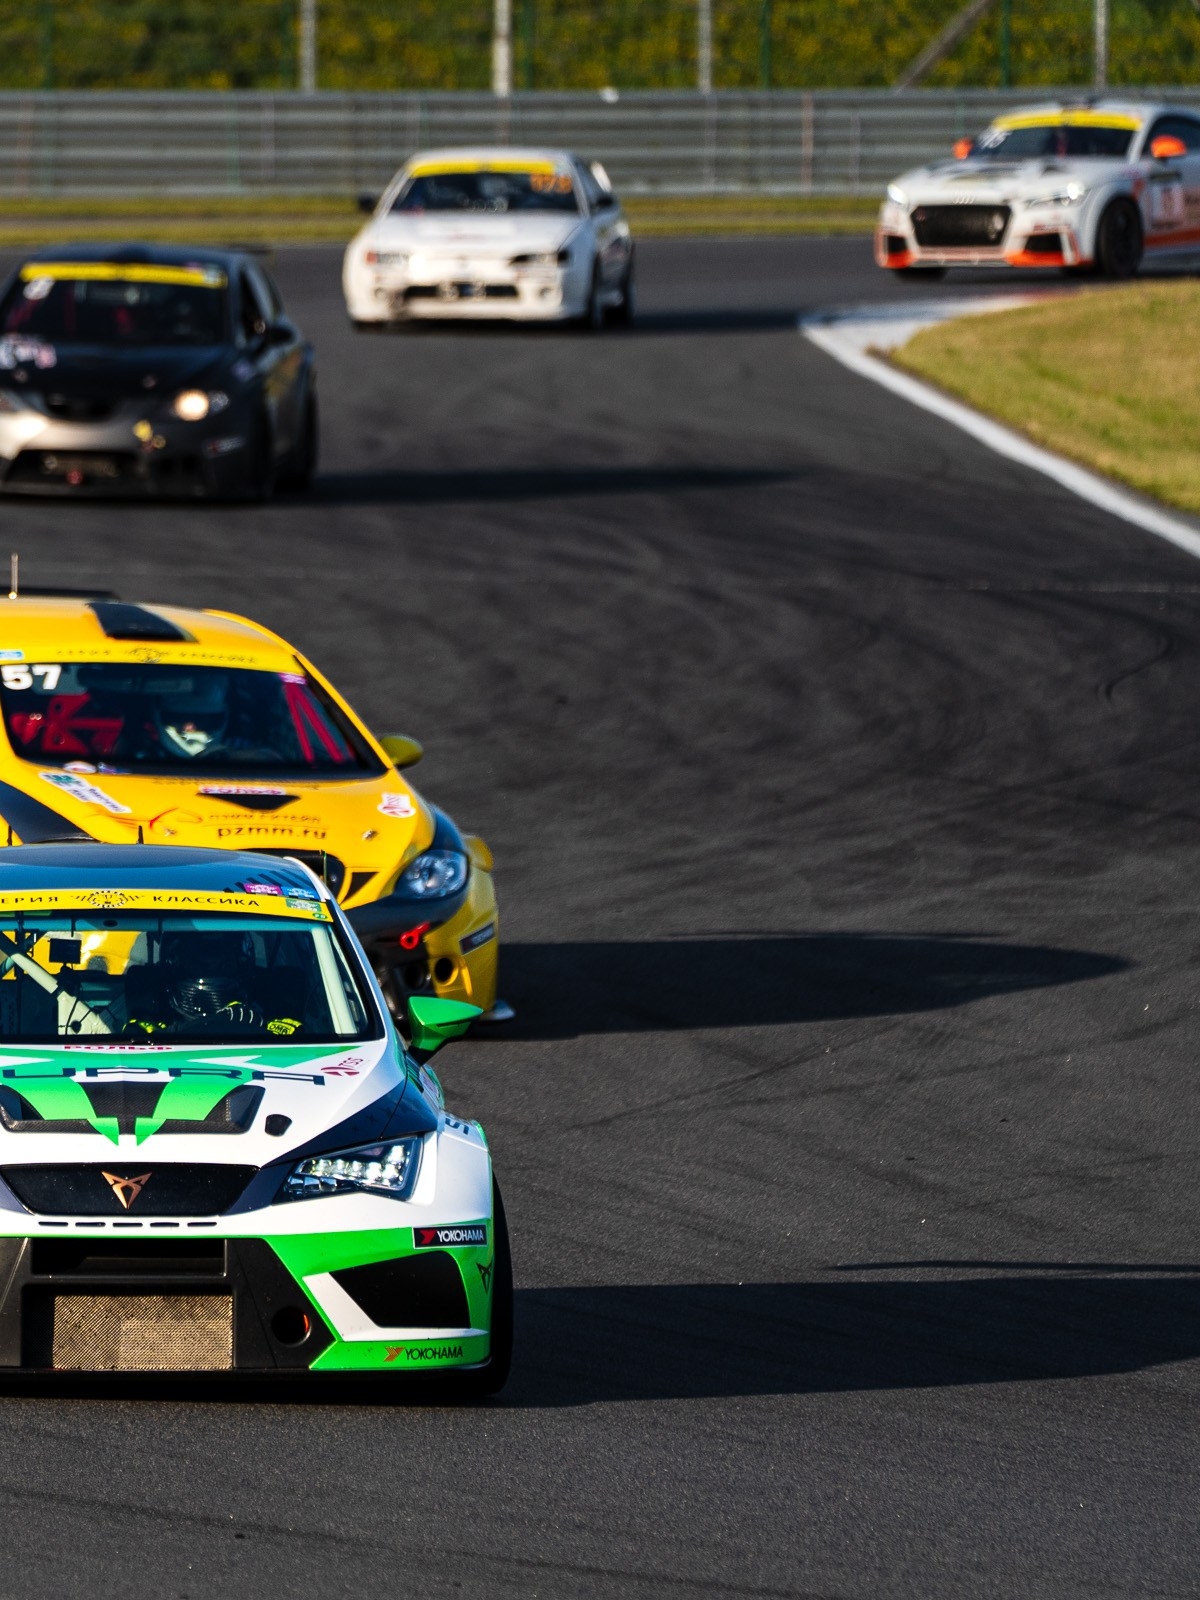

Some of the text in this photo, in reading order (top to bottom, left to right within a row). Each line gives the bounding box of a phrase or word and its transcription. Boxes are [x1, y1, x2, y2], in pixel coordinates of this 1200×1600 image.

[0, 664, 62, 690] 57
[217, 827, 326, 840] pzmm.ru
[152, 895, 260, 907] КЛАССИКА
[437, 1229, 484, 1242] YOKOHAMA
[406, 1346, 464, 1361] YOKOHAMA
